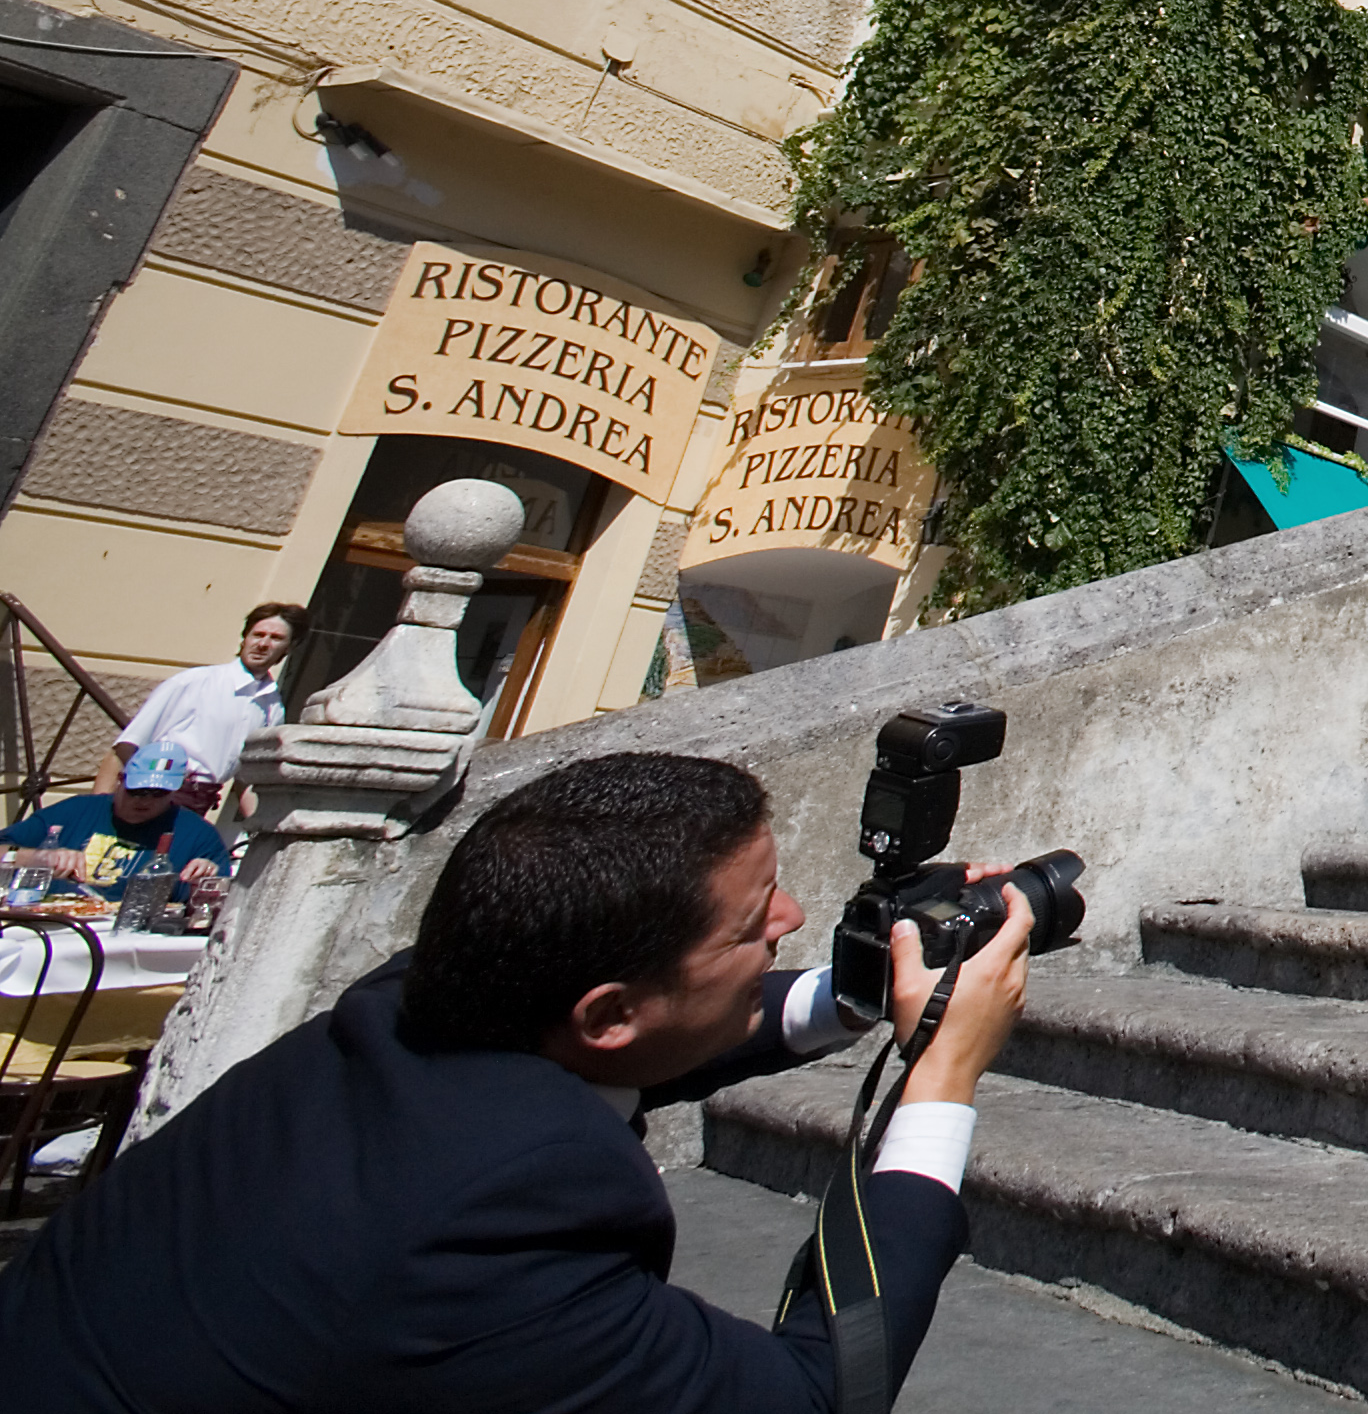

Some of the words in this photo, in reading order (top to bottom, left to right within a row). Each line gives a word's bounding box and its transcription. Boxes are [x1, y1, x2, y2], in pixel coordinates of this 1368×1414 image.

[411, 262, 708, 380] RISTORANTE
[434, 318, 657, 415] PIZZERIA
[384, 374, 432, 414] S.
[447, 379, 654, 475] ANDREA
[726, 388, 923, 447] RISTORA
[739, 444, 901, 489] PIZZERIA
[709, 506, 740, 544] S.
[748, 495, 902, 545] ANDREA
